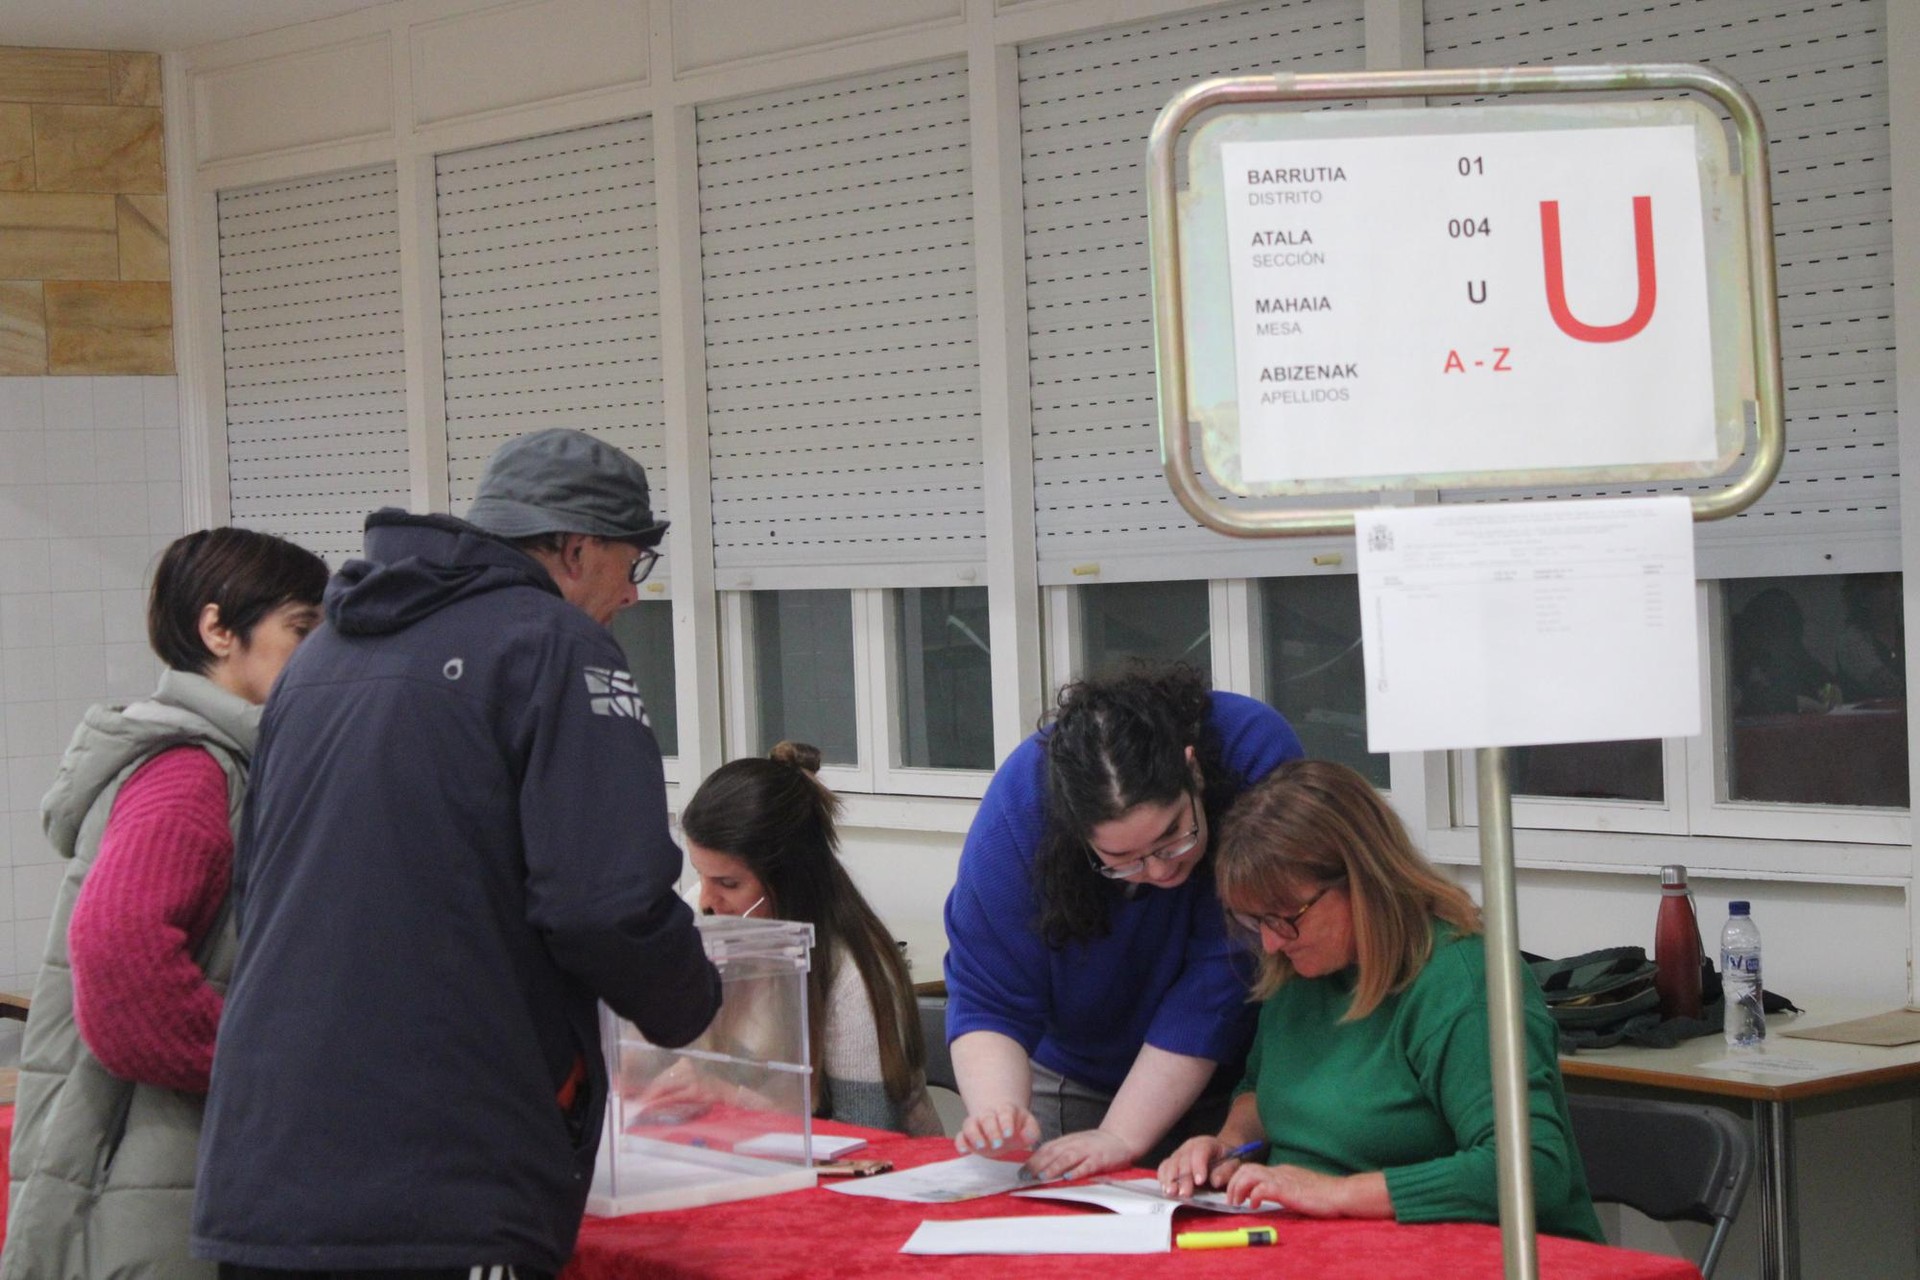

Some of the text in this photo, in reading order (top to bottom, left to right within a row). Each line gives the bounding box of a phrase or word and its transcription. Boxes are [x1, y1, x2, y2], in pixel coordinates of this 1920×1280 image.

[1458, 156, 1483, 176] 01
[1248, 167, 1346, 184] BARRUTIA
[1248, 190, 1323, 206] DISTRITO
[1448, 218, 1491, 239] 004
[1252, 230, 1313, 246] ATALA
[1252, 249, 1325, 268] SECCIÓN
[1539, 196, 1656, 343] U
[1468, 281, 1487, 304] U
[1256, 297, 1331, 313] MAHAIA
[1256, 321, 1302, 336] MESA
[1444, 350, 1465, 373] A
[1493, 348, 1512, 372] Z
[1260, 364, 1358, 382] ABIZENAK
[1261, 387, 1350, 404] APELLIDOS
